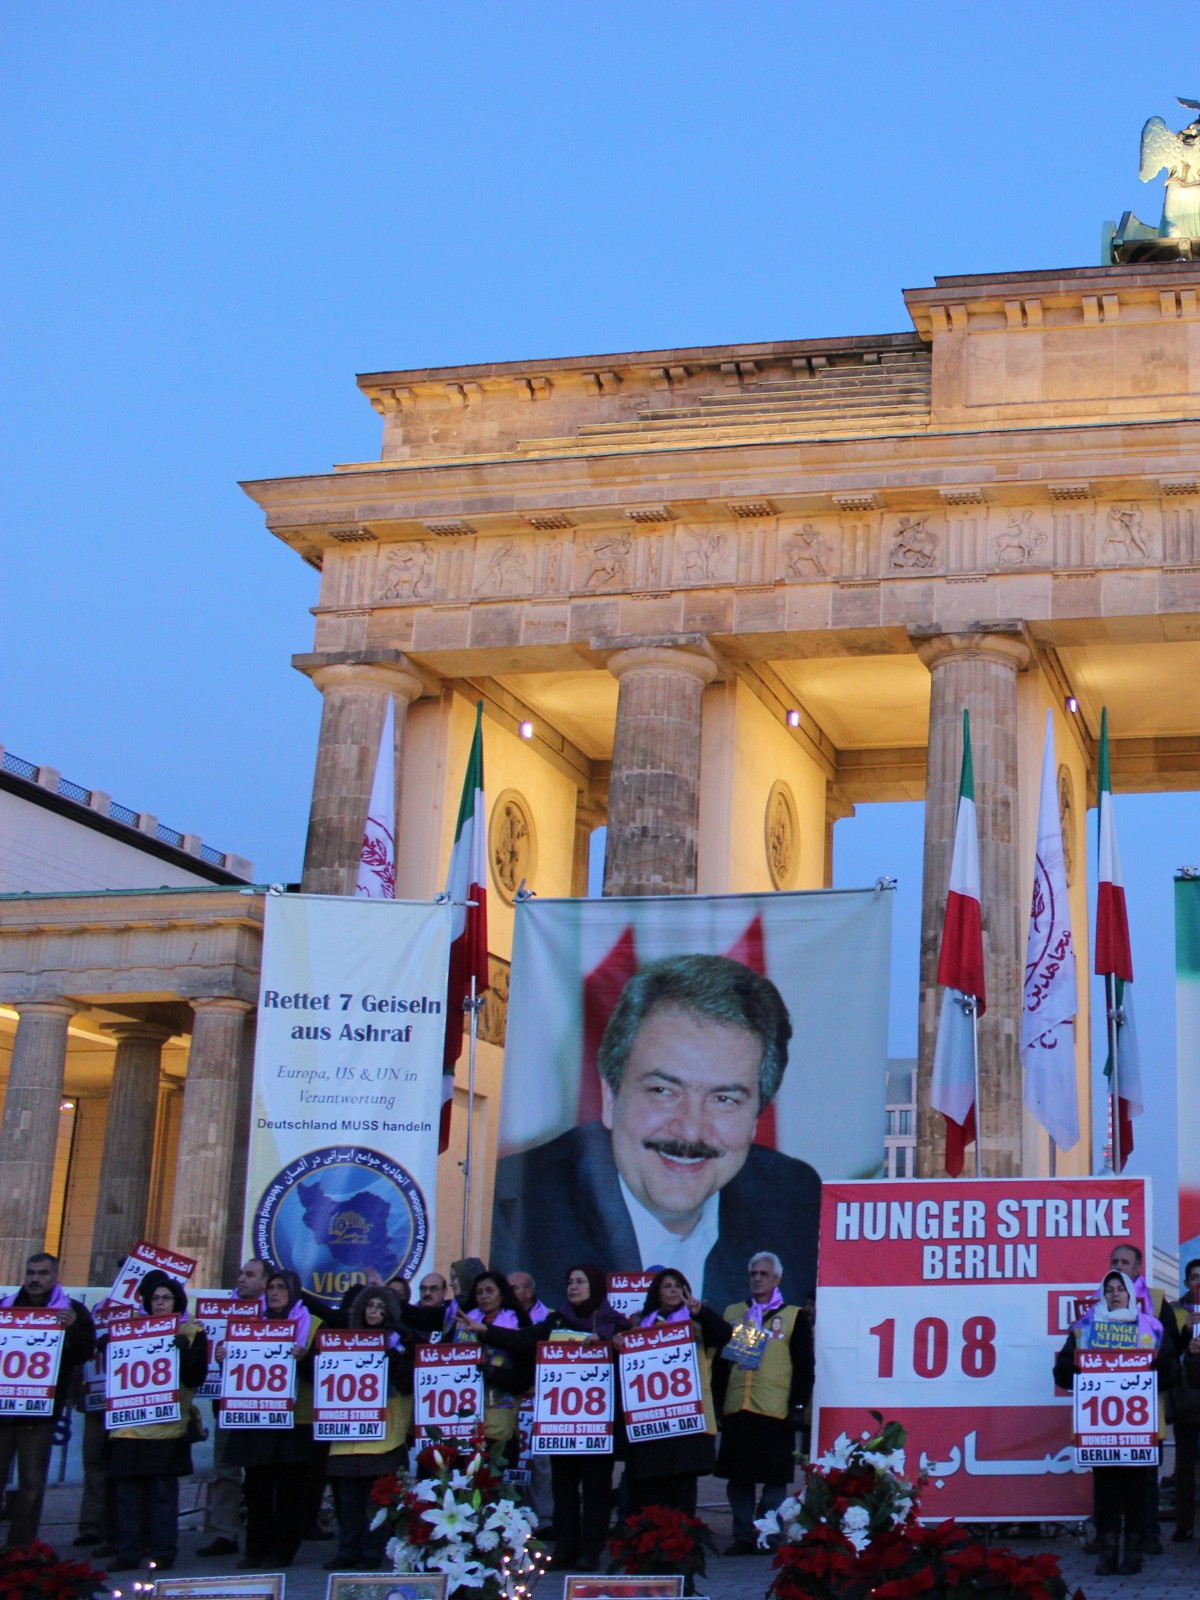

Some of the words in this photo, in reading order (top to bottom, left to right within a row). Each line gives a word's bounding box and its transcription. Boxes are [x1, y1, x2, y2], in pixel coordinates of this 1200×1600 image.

[264, 990, 331, 1011] Rettet
[340, 993, 353, 1011] 7
[361, 994, 441, 1015] Geiseln
[291, 1025, 331, 1041] aus
[339, 1024, 413, 1043] Ashraf
[276, 1065, 330, 1082] Europa,
[335, 1067, 355, 1080] US
[360, 1068, 373, 1081] &
[377, 1068, 401, 1081] UN
[404, 1069, 418, 1082] in
[299, 1090, 396, 1109] Verantwortung
[257, 1118, 338, 1130] Deutschland
[341, 1120, 379, 1131] MUSS
[382, 1121, 431, 1132] handeln
[261, 1185, 284, 1218] Verband
[409, 1189, 425, 1241] Associations
[836, 1200, 986, 1241] HUNGER
[997, 1199, 1131, 1239] STRIKE
[258, 1215, 270, 1261] Iranischer
[410, 1243, 423, 1271] Iranian
[922, 1243, 1038, 1281] BERLIN
[404, 1269, 412, 1279] of
[112, 1325, 132, 1337] غذا
[138, 1317, 176, 1336] اعتصاب
[231, 1324, 251, 1337] غذا
[254, 1322, 295, 1339] اعتصاب
[648, 1325, 689, 1345] اعتصاب
[321, 1335, 341, 1347] غذا
[345, 1334, 384, 1350] اعتصاب
[624, 1335, 645, 1348] غذا
[420, 1350, 439, 1362] غذا
[442, 1347, 482, 1362] اعتصاب
[543, 1345, 563, 1359] غذا
[567, 1346, 608, 1361] اعتصاب
[0, 1351, 51, 1379] 08
[1080, 1354, 1101, 1368] غذا
[1105, 1353, 1152, 1371] اعتصاب
[114, 1358, 172, 1390] 108
[230, 1363, 287, 1392] 108
[17, 1386, 48, 1397] STRIKE
[320, 1373, 379, 1402] 108
[629, 1368, 692, 1403] 108
[26, 1400, 48, 1410] DAY
[144, 1393, 173, 1404] STRIKE
[227, 1400, 256, 1410] HUNGER
[258, 1400, 287, 1410] STRIKE
[422, 1388, 477, 1418] 108
[542, 1386, 606, 1416] 108
[112, 1409, 146, 1423] BERLIN
[156, 1404, 174, 1417] DAY
[225, 1412, 260, 1424] BERLIN
[269, 1412, 288, 1424] DAY
[318, 1410, 348, 1420] HUNGER
[350, 1410, 379, 1420] STRIKE
[632, 1409, 665, 1422] HUNGER
[666, 1403, 696, 1417] STRIKE
[1081, 1395, 1149, 1427] 108
[318, 1423, 351, 1435] BERLIN
[359, 1423, 380, 1435] DAY
[540, 1424, 574, 1434] HUNGER
[576, 1424, 606, 1434] STRIKE
[633, 1422, 670, 1437] BERLIN
[680, 1416, 699, 1431] DAY
[538, 1437, 577, 1449] BERLIN
[586, 1437, 606, 1449] DAY
[1082, 1435, 1117, 1446] HUNGER
[1118, 1435, 1150, 1445] STRIKE
[1081, 1449, 1121, 1462] BERLIN
[1130, 1448, 1152, 1461] DAY
